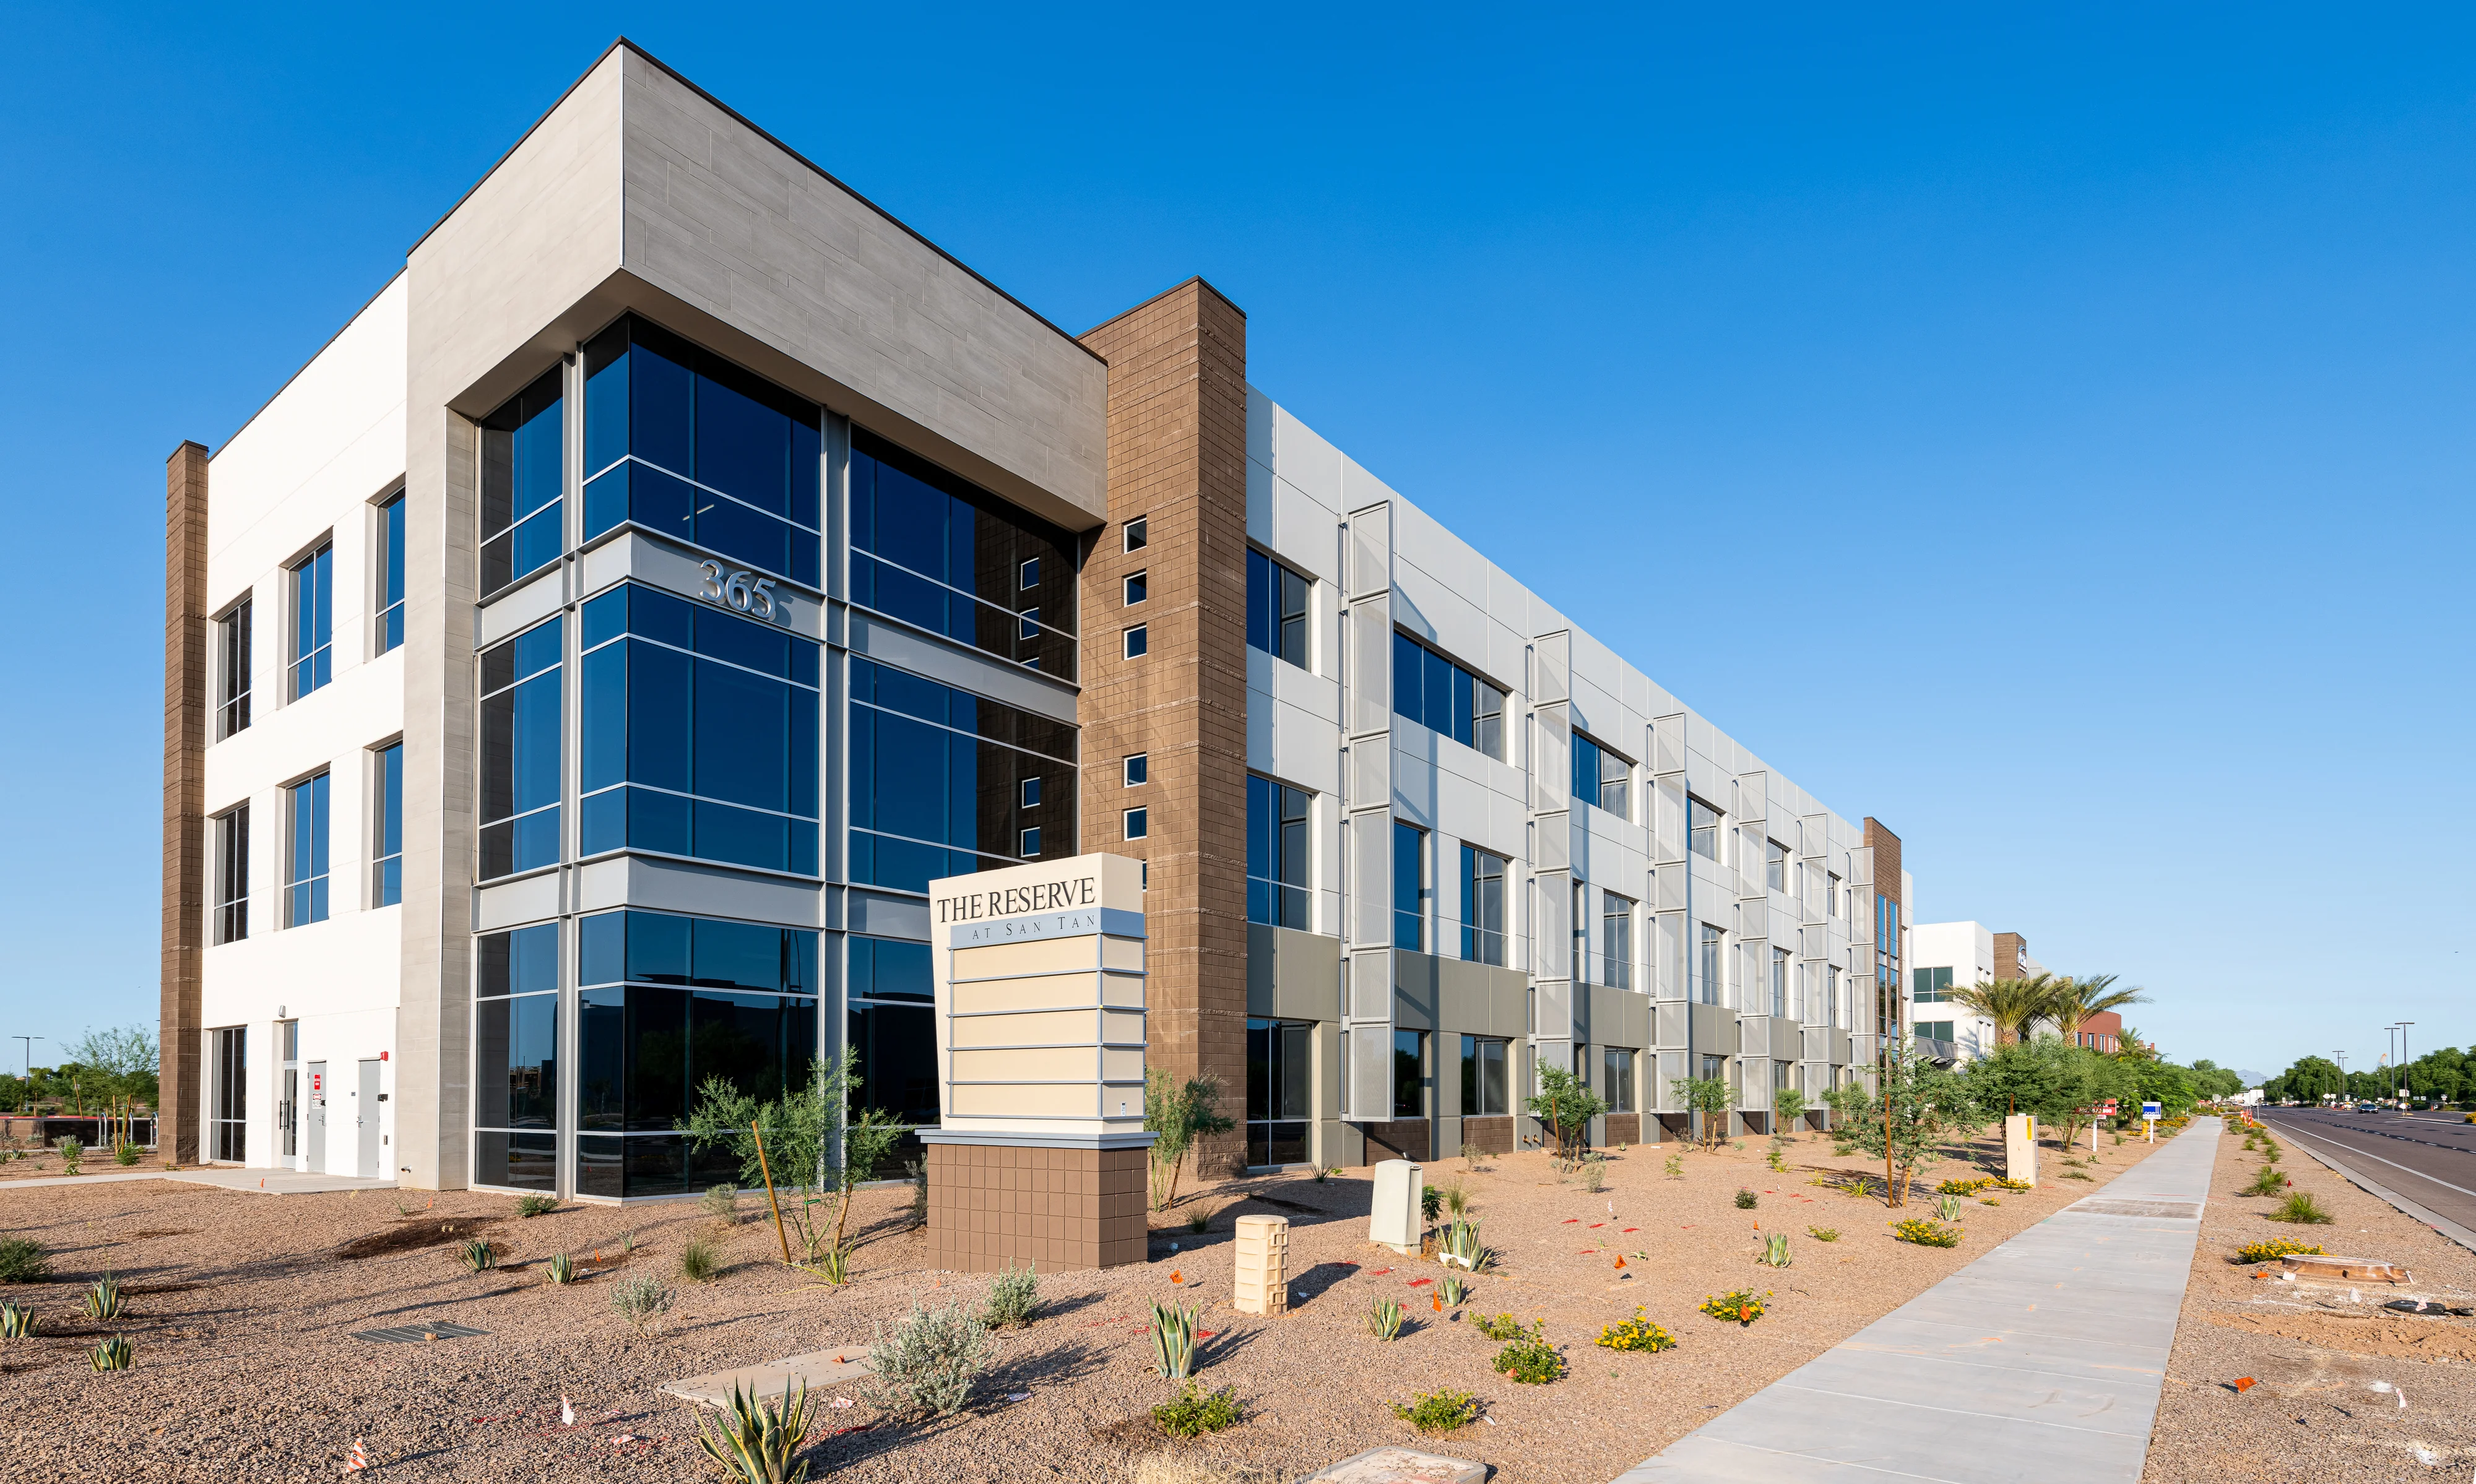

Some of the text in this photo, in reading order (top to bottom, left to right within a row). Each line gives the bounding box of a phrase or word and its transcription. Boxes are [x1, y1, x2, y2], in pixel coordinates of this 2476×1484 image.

[699, 559, 776, 618] 365
[937, 877, 1096, 923] THE RESERVE
[972, 915, 1094, 939] AT SAN TAN
